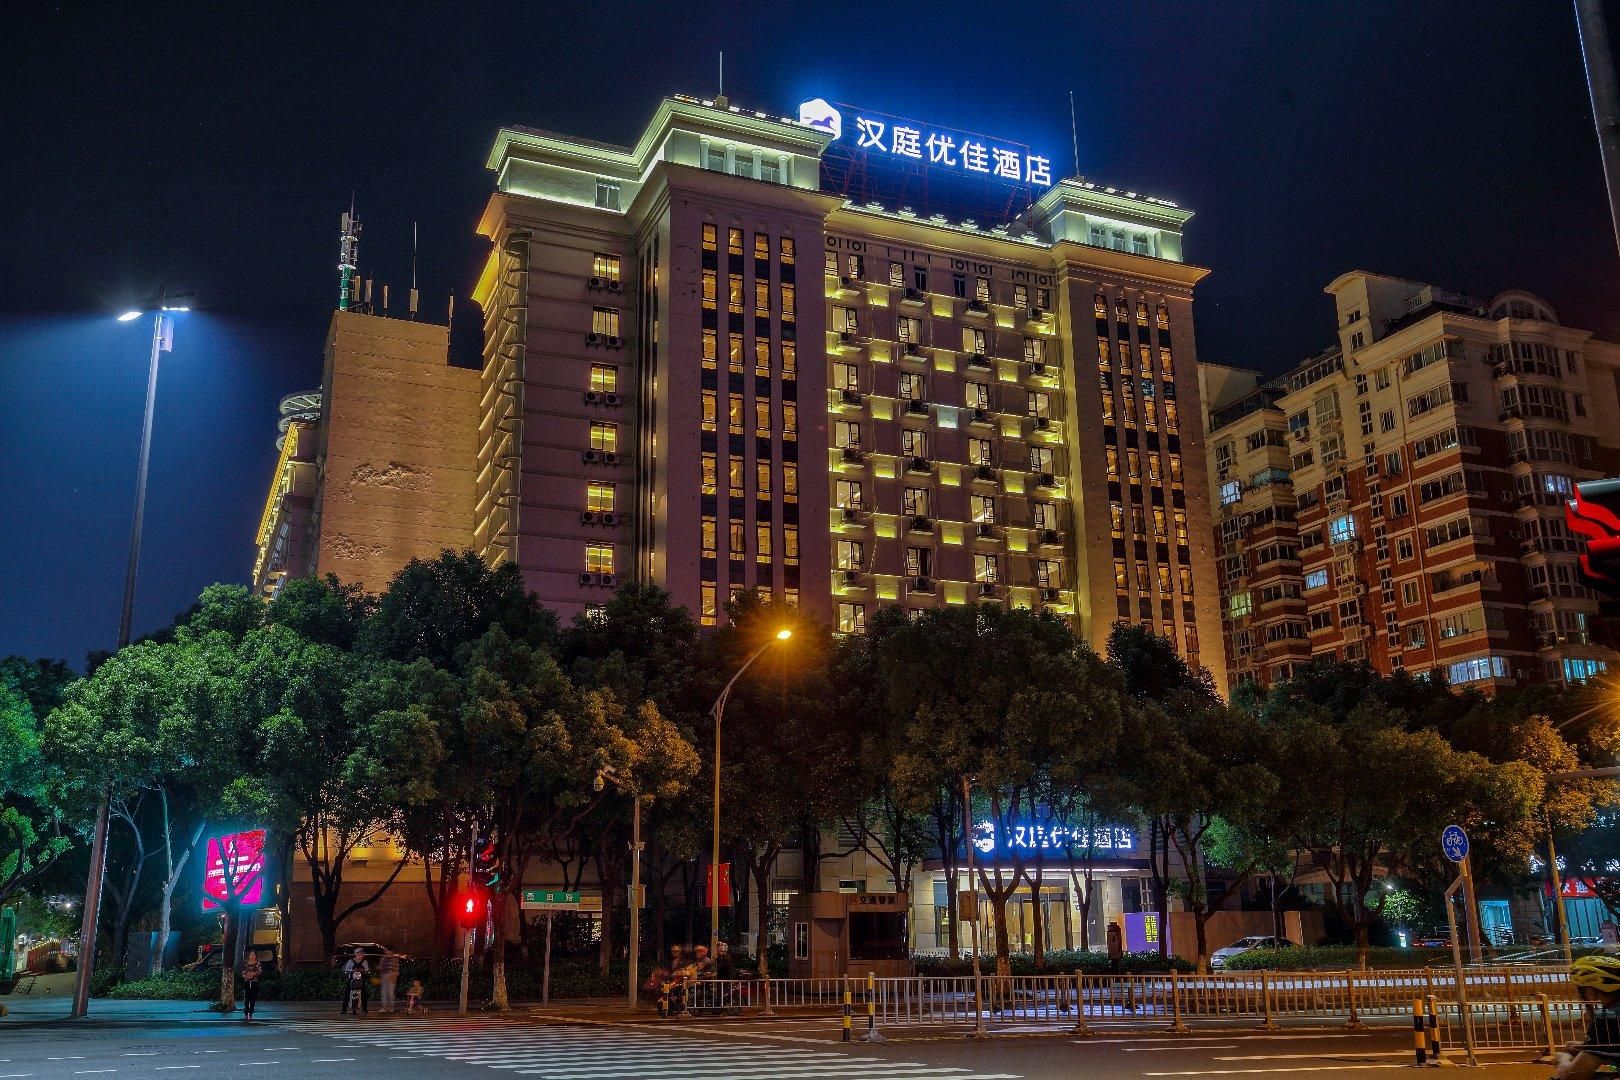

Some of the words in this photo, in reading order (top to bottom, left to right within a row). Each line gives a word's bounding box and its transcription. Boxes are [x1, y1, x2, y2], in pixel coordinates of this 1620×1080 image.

[856, 115, 1052, 187] 汉庭优佳酒店
